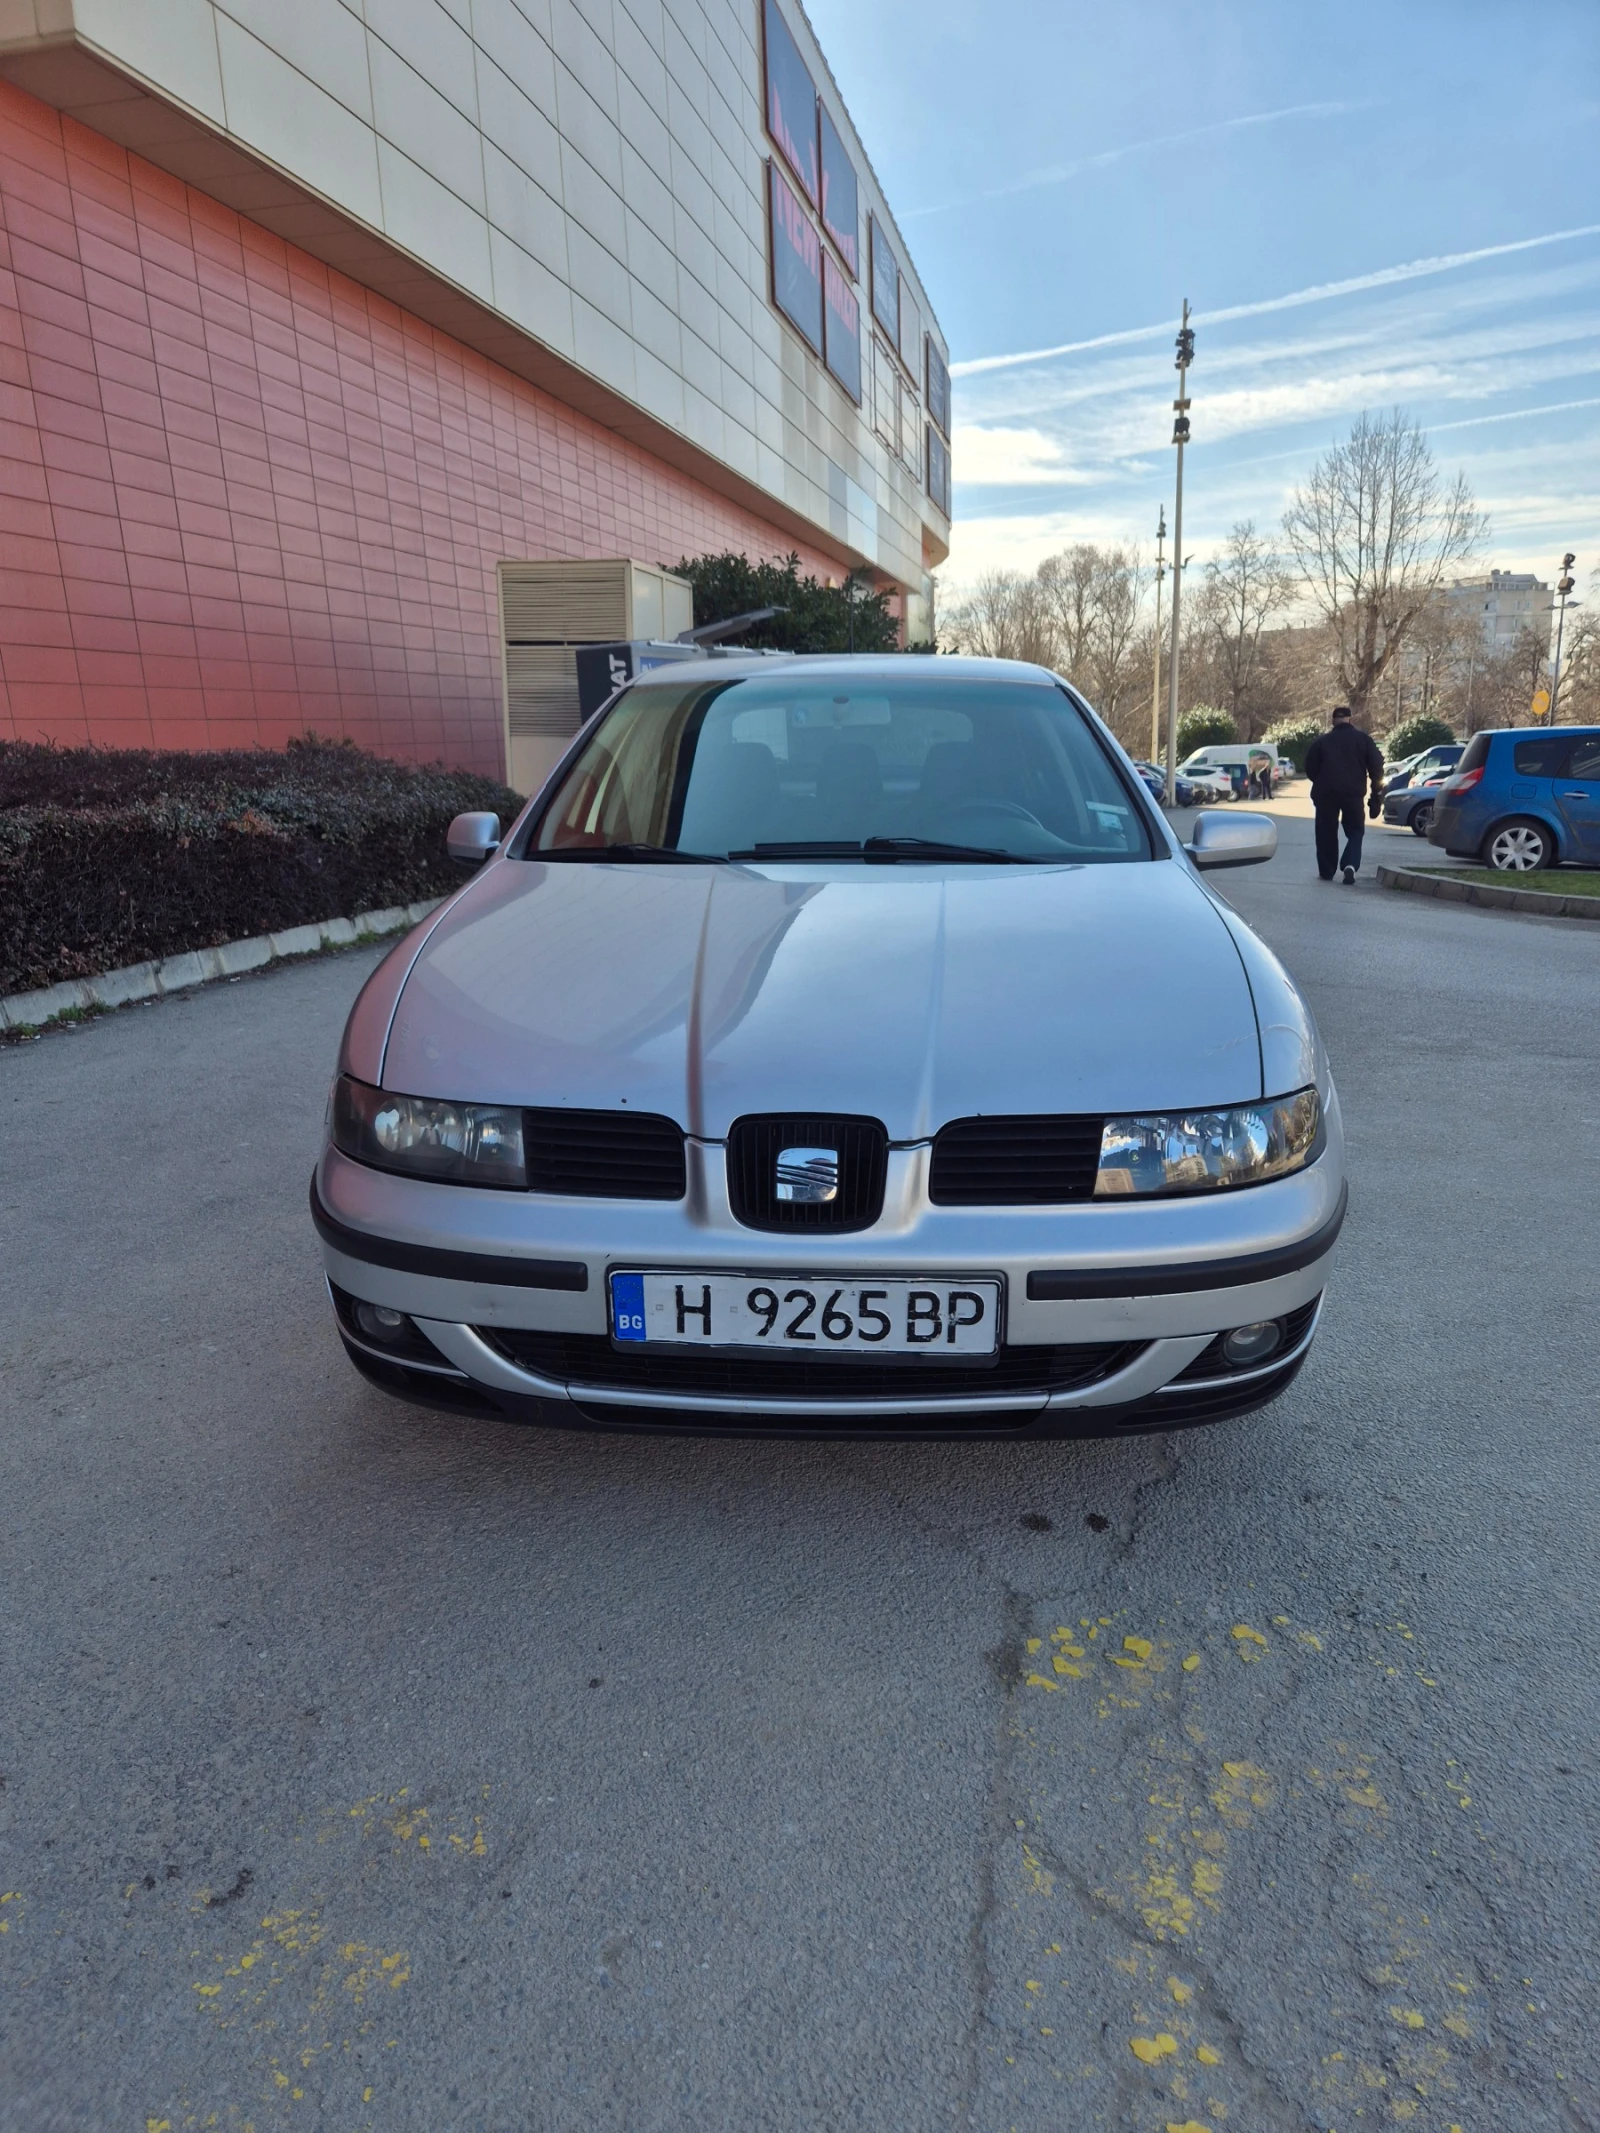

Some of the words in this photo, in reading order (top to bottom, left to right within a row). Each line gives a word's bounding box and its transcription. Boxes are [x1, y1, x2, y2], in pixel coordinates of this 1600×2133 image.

[618, 1314, 643, 1330] BG
[675, 1284, 712, 1336] H
[747, 1286, 892, 1342] 9265
[906, 1290, 985, 1344] BP
